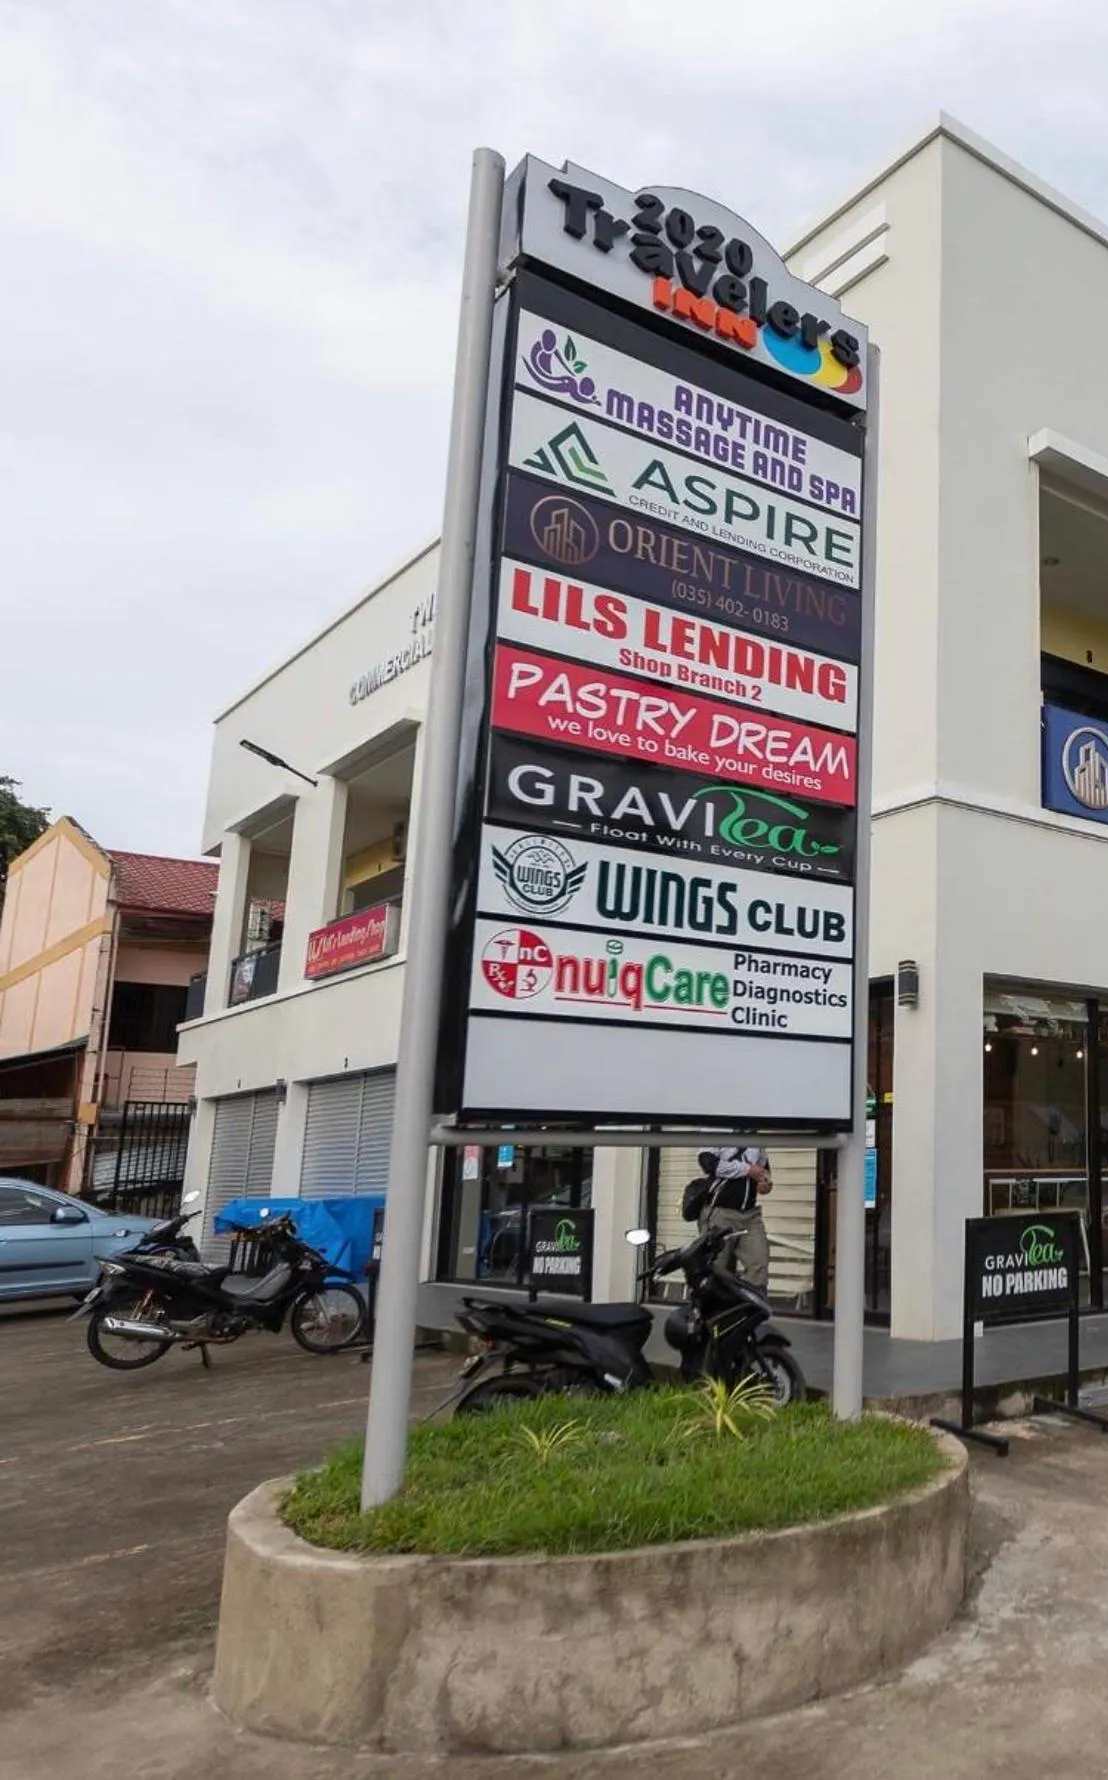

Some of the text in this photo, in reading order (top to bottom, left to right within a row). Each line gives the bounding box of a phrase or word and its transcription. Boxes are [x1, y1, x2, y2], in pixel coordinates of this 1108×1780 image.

[548, 178, 860, 368] Travelers
[634, 194, 754, 278] 2020
[605, 388, 857, 514] MASSAGE AND SPA
[674, 385, 807, 465] ANYTIME
[628, 495, 854, 584] CREDIT AND LENDING CORPORATION
[631, 459, 854, 569] ASPIRE
[608, 519, 846, 626] ORIENT LIVING
[671, 578, 713, 608] (035)
[752, 602, 791, 632] 0183
[511, 568, 848, 704] LILS LENDING
[618, 648, 763, 702] Shop Branch 2
[507, 662, 850, 781] PASTRY DREAM
[548, 715, 823, 792] we love to bake your desires
[518, 865, 561, 888] WINGS
[590, 823, 813, 873] Float With Every Cup
[522, 884, 553, 897] CLUB
[597, 860, 846, 943] WINGS CLUB
[732, 981, 848, 1009] Diagnostics
[734, 954, 833, 985] Pharmacy
[731, 1007, 788, 1029] Clinic
[533, 1256, 582, 1275] NO PARKING
[982, 1267, 1068, 1299] NO PARKING
